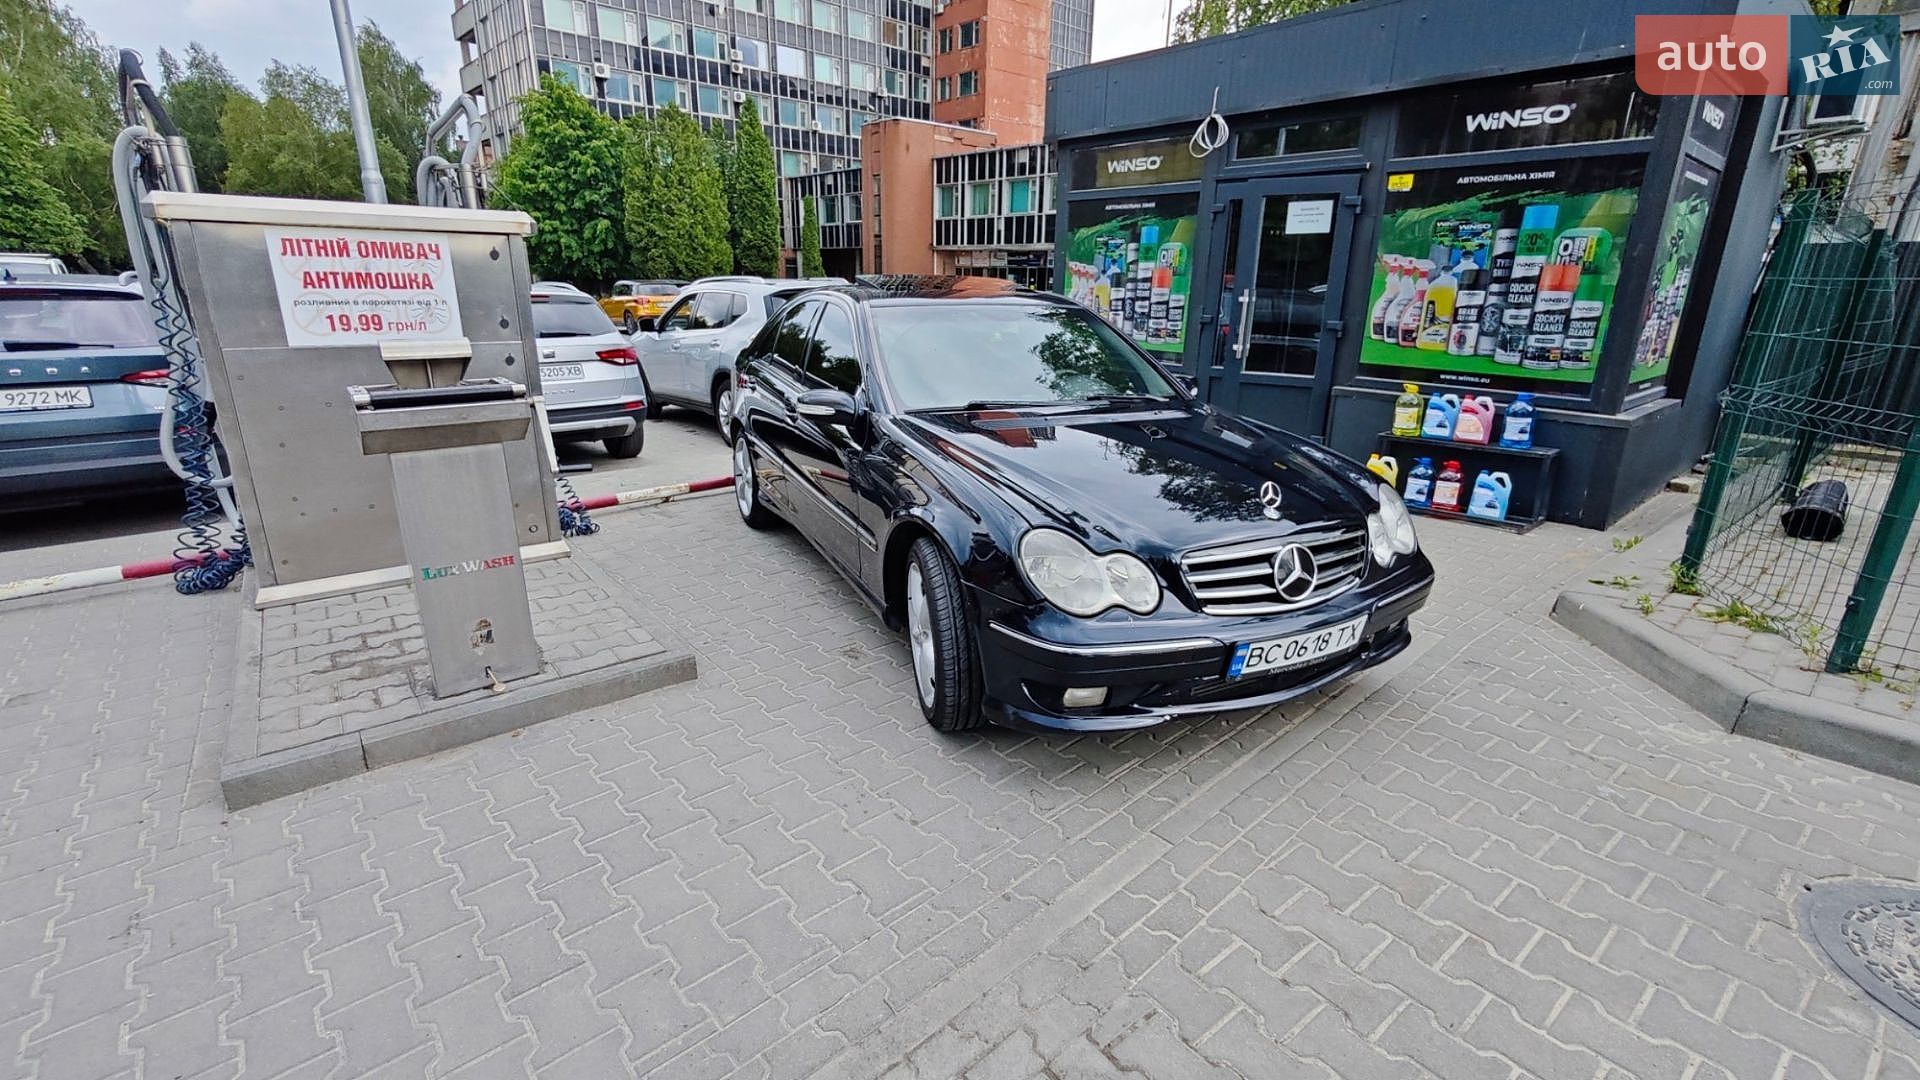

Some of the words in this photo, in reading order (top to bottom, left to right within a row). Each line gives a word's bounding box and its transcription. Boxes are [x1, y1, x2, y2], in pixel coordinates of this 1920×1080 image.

[1457, 174, 1527, 184] АВТОМОБІЛЬНА
[281, 237, 350, 257] ЛІТНІЙ
[356, 240, 442, 260] ОМИВАЧ
[302, 271, 434, 290] АНТИМОШКА
[325, 314, 383, 334] 19,99
[388, 319, 428, 335] грн/л
[5, 391, 50, 406] 9272
[54, 389, 84, 404] MK
[1246, 643, 1282, 668] BC
[1283, 632, 1332, 661] 0618
[1335, 622, 1361, 648] TX
